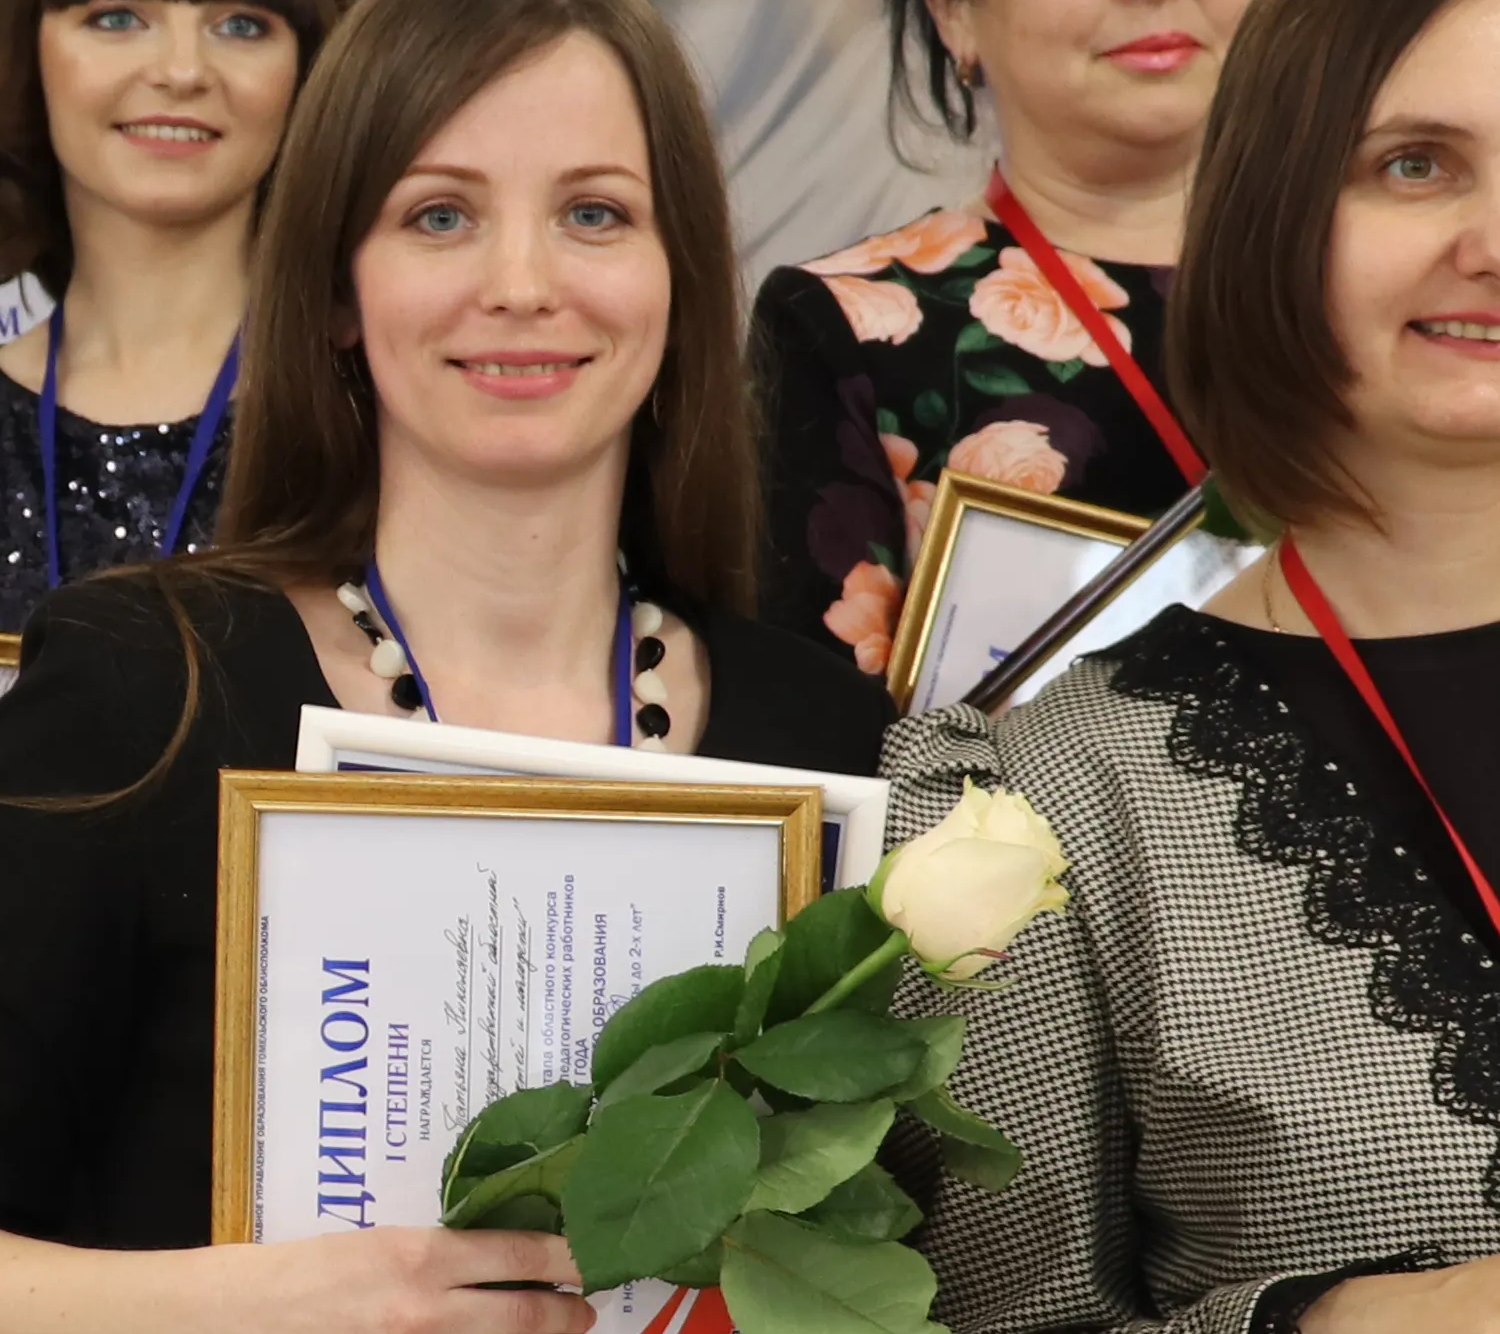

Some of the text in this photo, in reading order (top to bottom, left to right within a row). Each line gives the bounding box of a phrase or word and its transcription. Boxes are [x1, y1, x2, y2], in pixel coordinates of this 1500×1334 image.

[441, 912, 469, 1035] Николаевна
[560, 873, 575, 1082] педагогических работников
[592, 913, 607, 1026] ОБРАЗОВАНИЯ
[630, 936, 641, 957] 2-х
[630, 962, 642, 979] до
[714, 885, 726, 957] Р.И.Смирнов
[542, 891, 558, 1083] тапа областного конкурса
[254, 915, 269, 1244] ГЛАВНОЕ УПРАВЛЕНИЕ ОБРАЗОВАНИЯ ГОМЕЛЬСКОГО ОБЛИСПОЛКОМА
[316, 956, 380, 1229] ДИПЛОМ
[385, 1022, 409, 1162] I СТЕПЕНИ
[419, 1038, 432, 1140] НАГРАЖДАЕТСЯ
[574, 1038, 588, 1075] ГОДА
